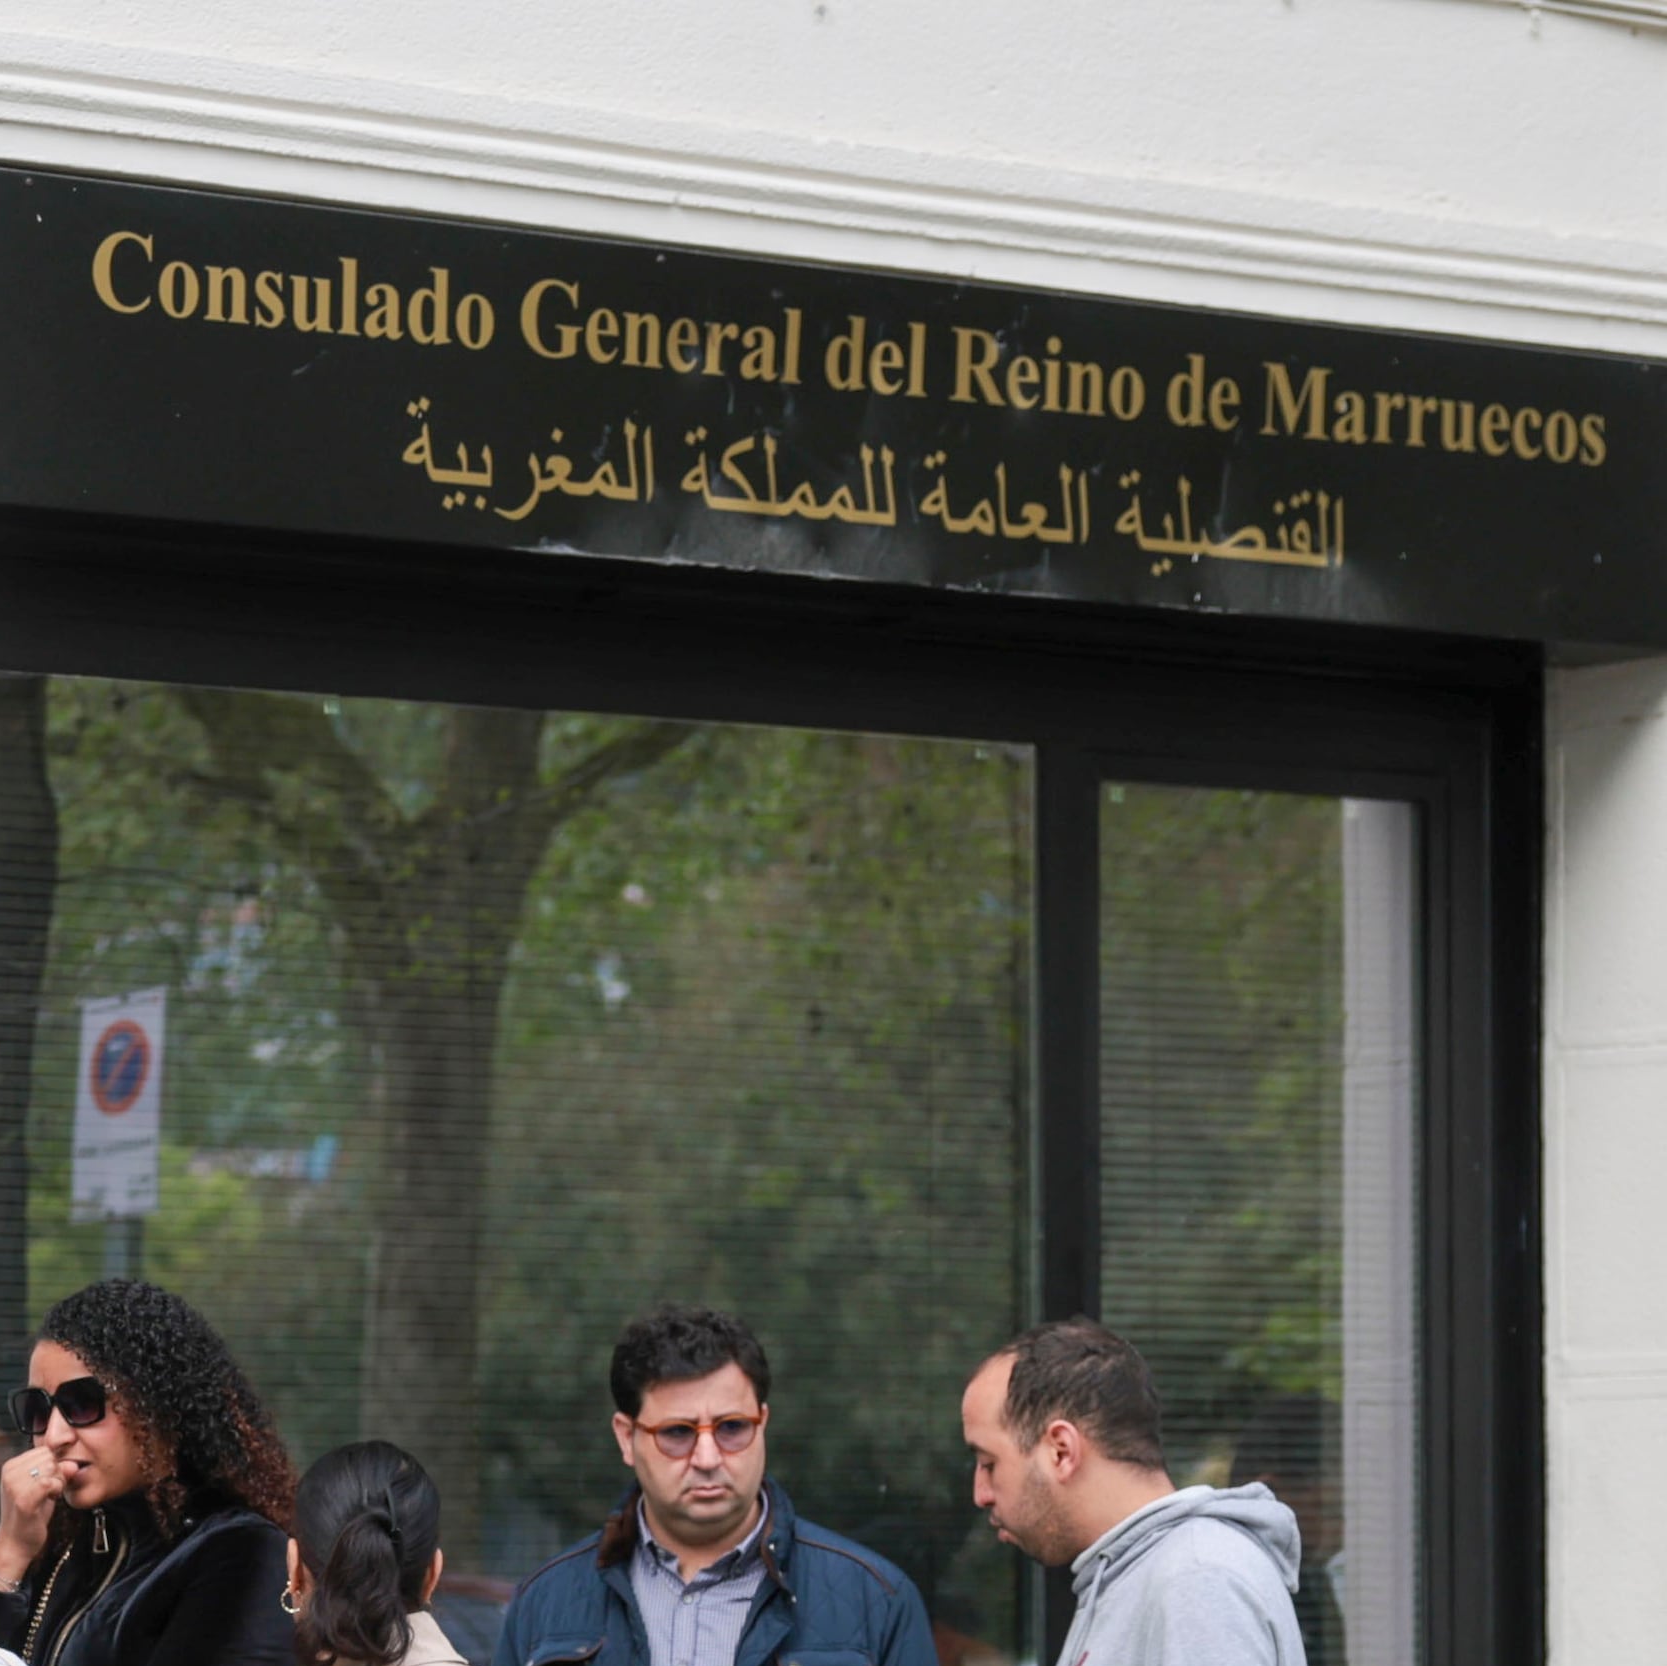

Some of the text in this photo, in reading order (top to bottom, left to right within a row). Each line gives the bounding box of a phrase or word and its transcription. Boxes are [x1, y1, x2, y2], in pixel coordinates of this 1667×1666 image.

[93, 232, 1608, 468] Consulado General del Reino de Marruecos
[403, 399, 1347, 576] القنصلية العامة للمملكة المغربية
